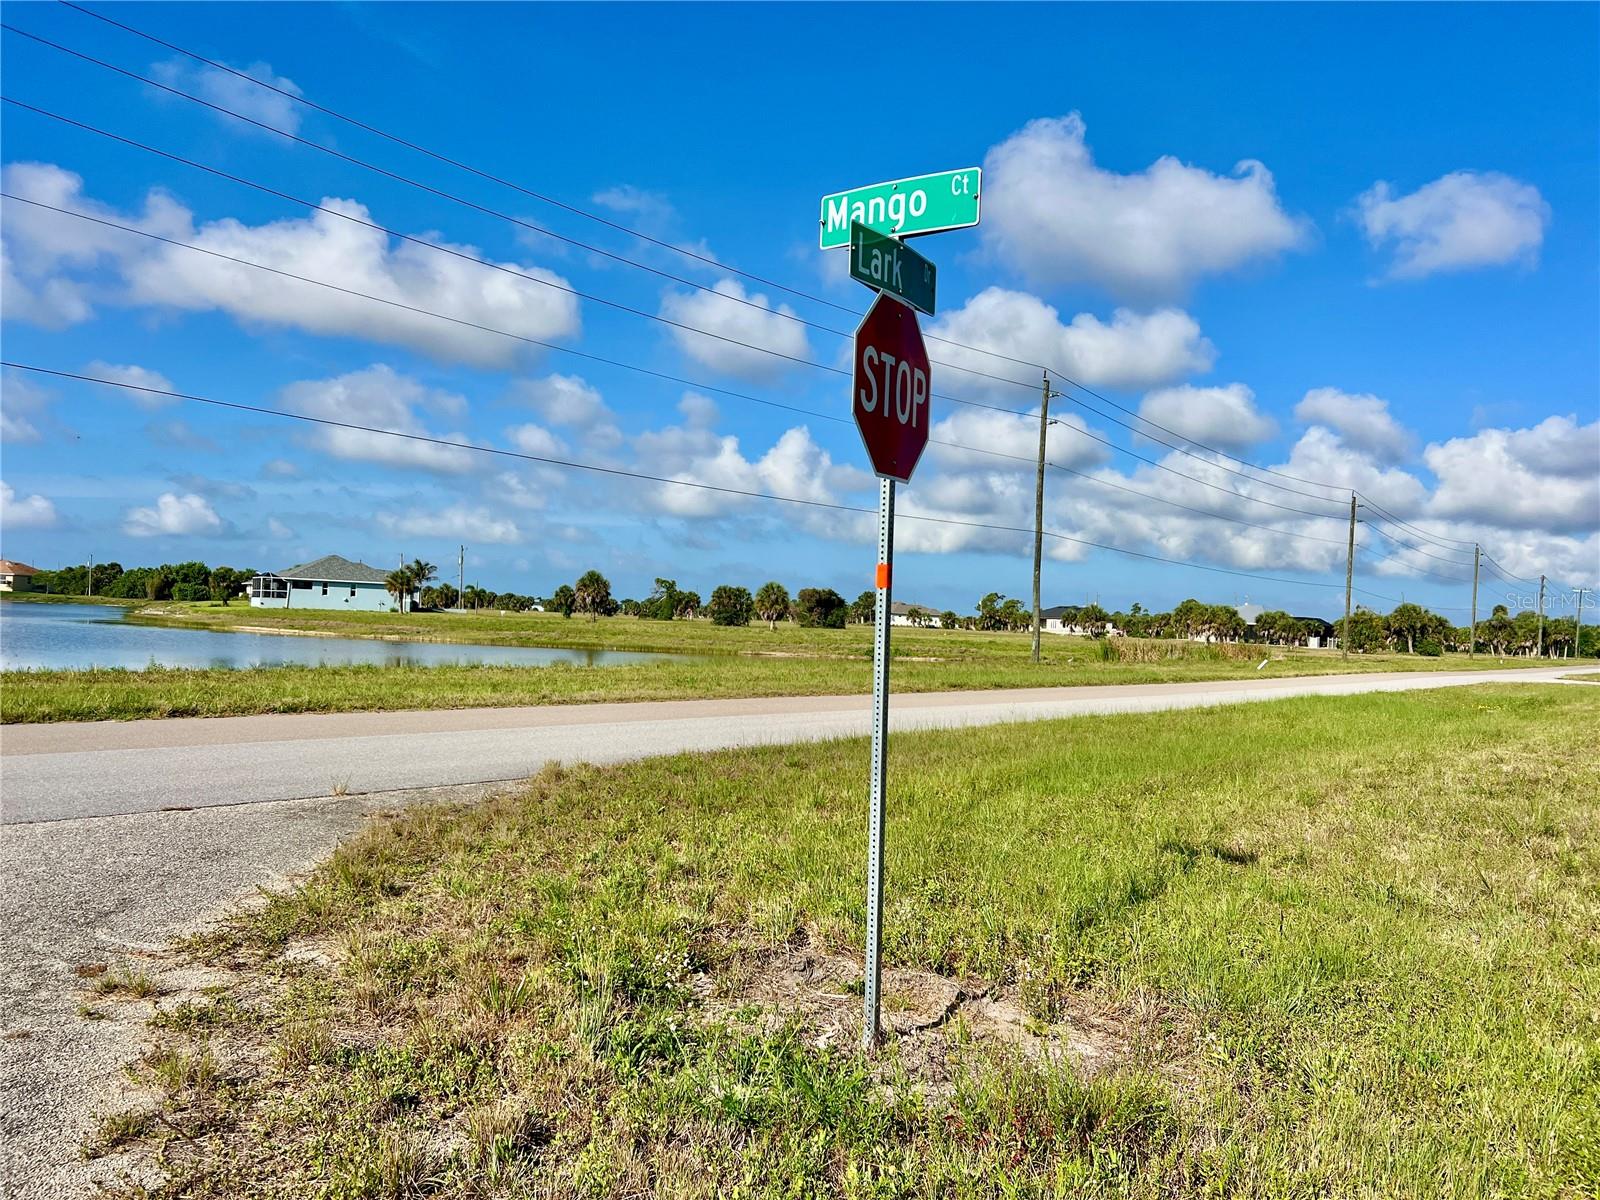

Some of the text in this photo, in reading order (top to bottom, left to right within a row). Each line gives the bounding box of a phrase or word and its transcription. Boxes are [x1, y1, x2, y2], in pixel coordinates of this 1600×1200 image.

[827, 174, 969, 233] Mango Ct
[857, 231, 903, 289] Lark
[860, 345, 926, 428] STOP
